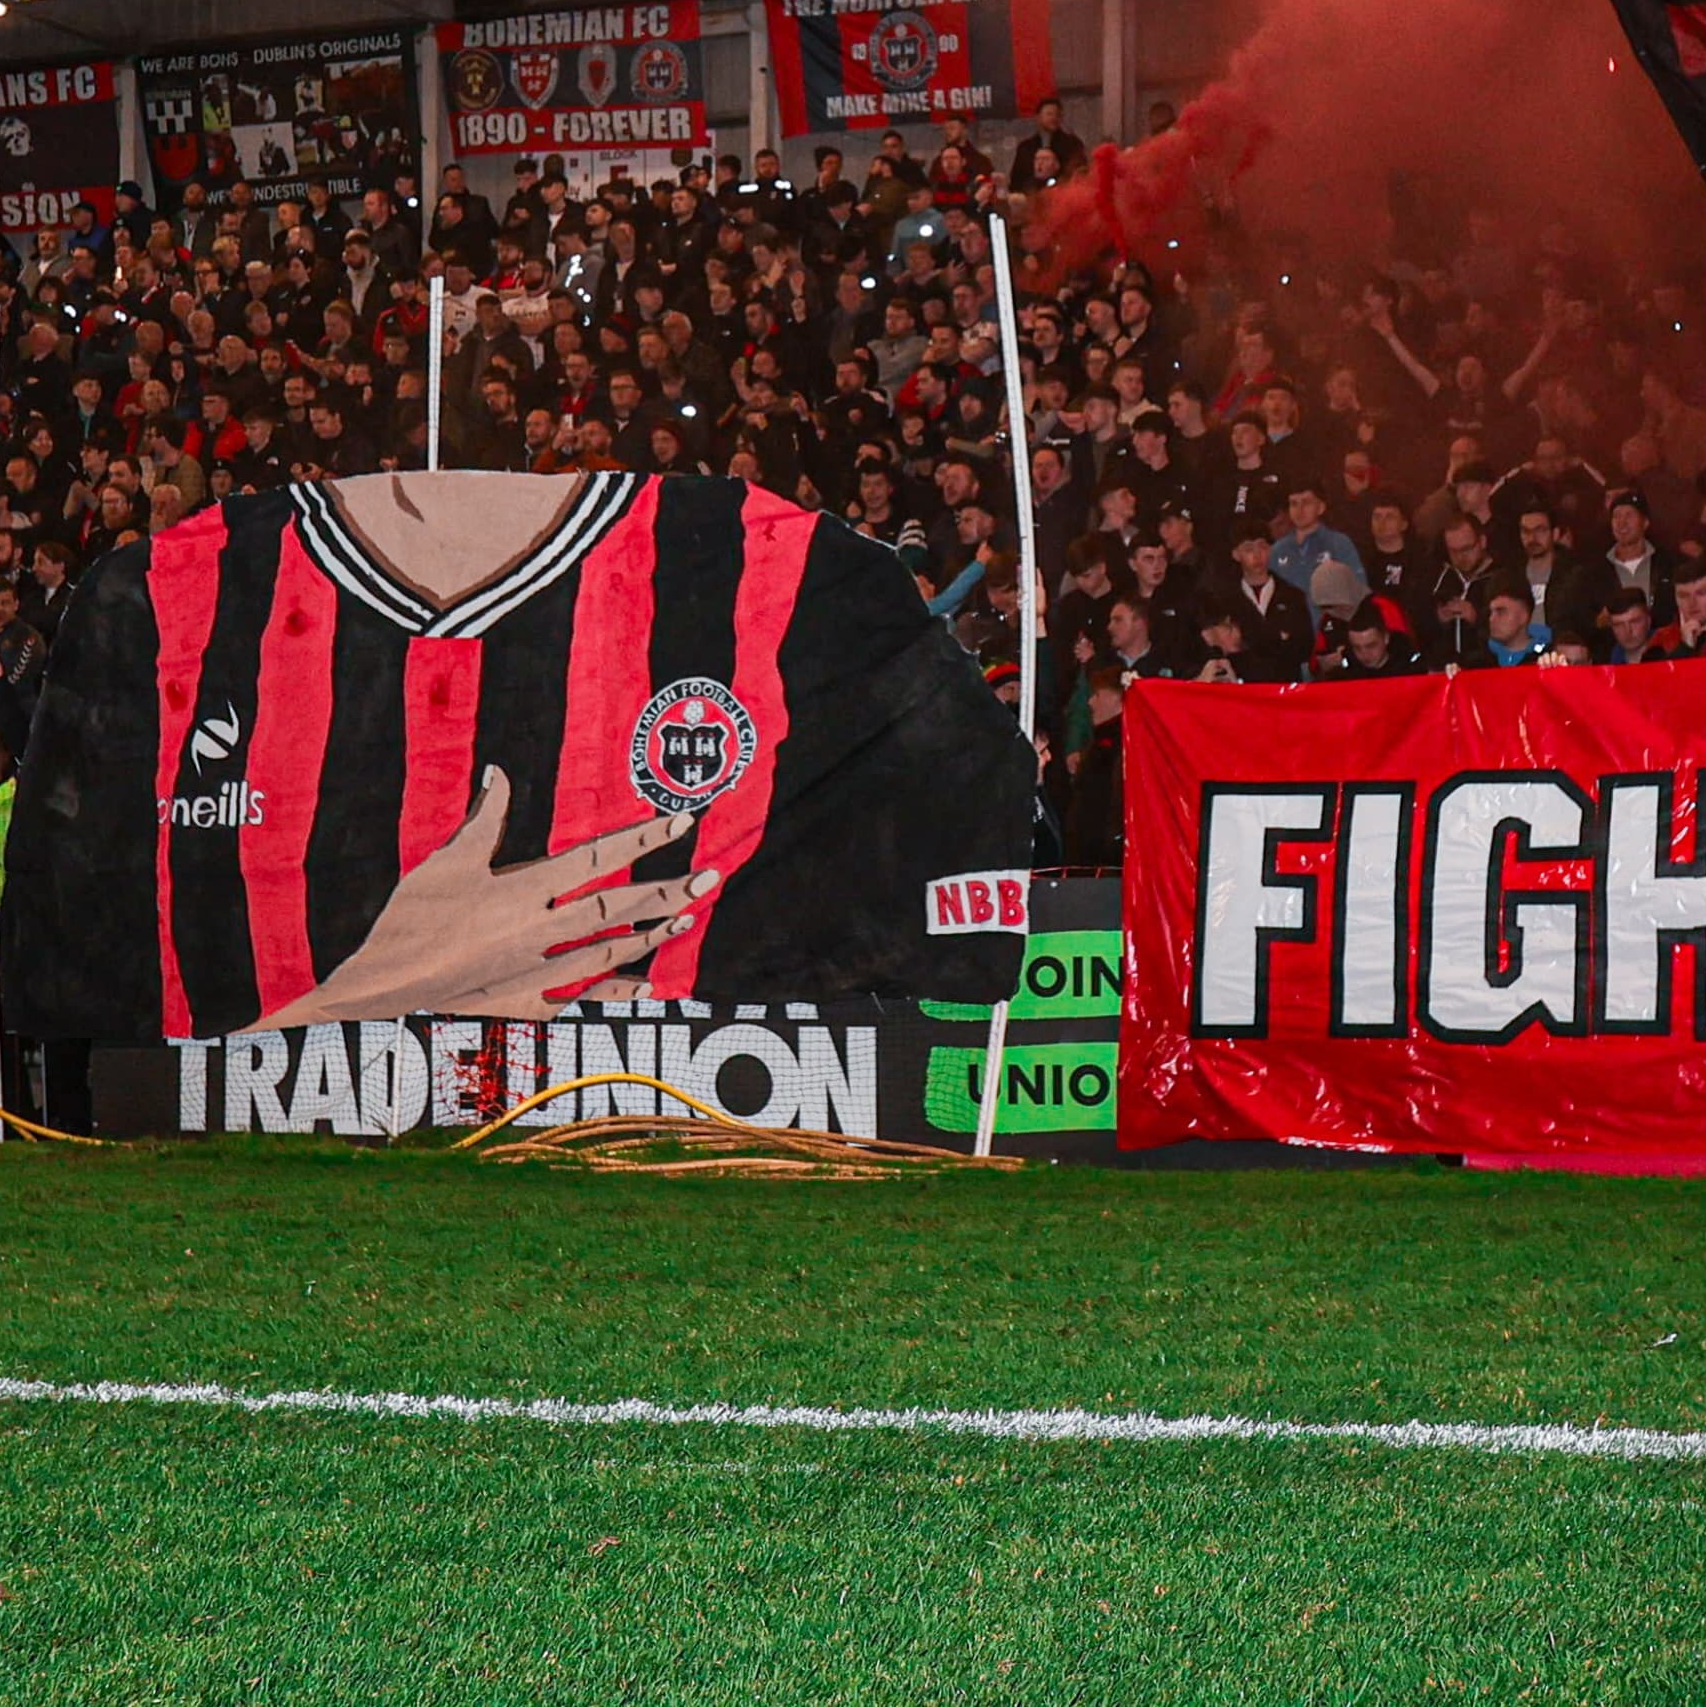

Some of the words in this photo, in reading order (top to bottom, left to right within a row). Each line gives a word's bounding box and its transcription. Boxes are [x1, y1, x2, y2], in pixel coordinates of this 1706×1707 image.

[464, 8, 625, 48] BOHEMIAN
[633, 5, 670, 38] FC
[56, 65, 96, 102] FC
[142, 58, 164, 74] WE
[167, 55, 195, 71] ARE
[198, 51, 239, 69] BOHS
[826, 94, 878, 119] MAKE
[882, 91, 930, 114] MINE
[457, 112, 527, 149] 1890
[553, 107, 692, 143] FOREVER
[633, 687, 679, 773] BOHEMIAN
[681, 682, 749, 727] FOOTBALL
[935, 879, 1026, 927] NBB
[1026, 955, 1123, 998] OIN
[166, 1021, 483, 1137] TRADE
[506, 1021, 877, 1145] UNION
[968, 1063, 1111, 1108] UNIO
